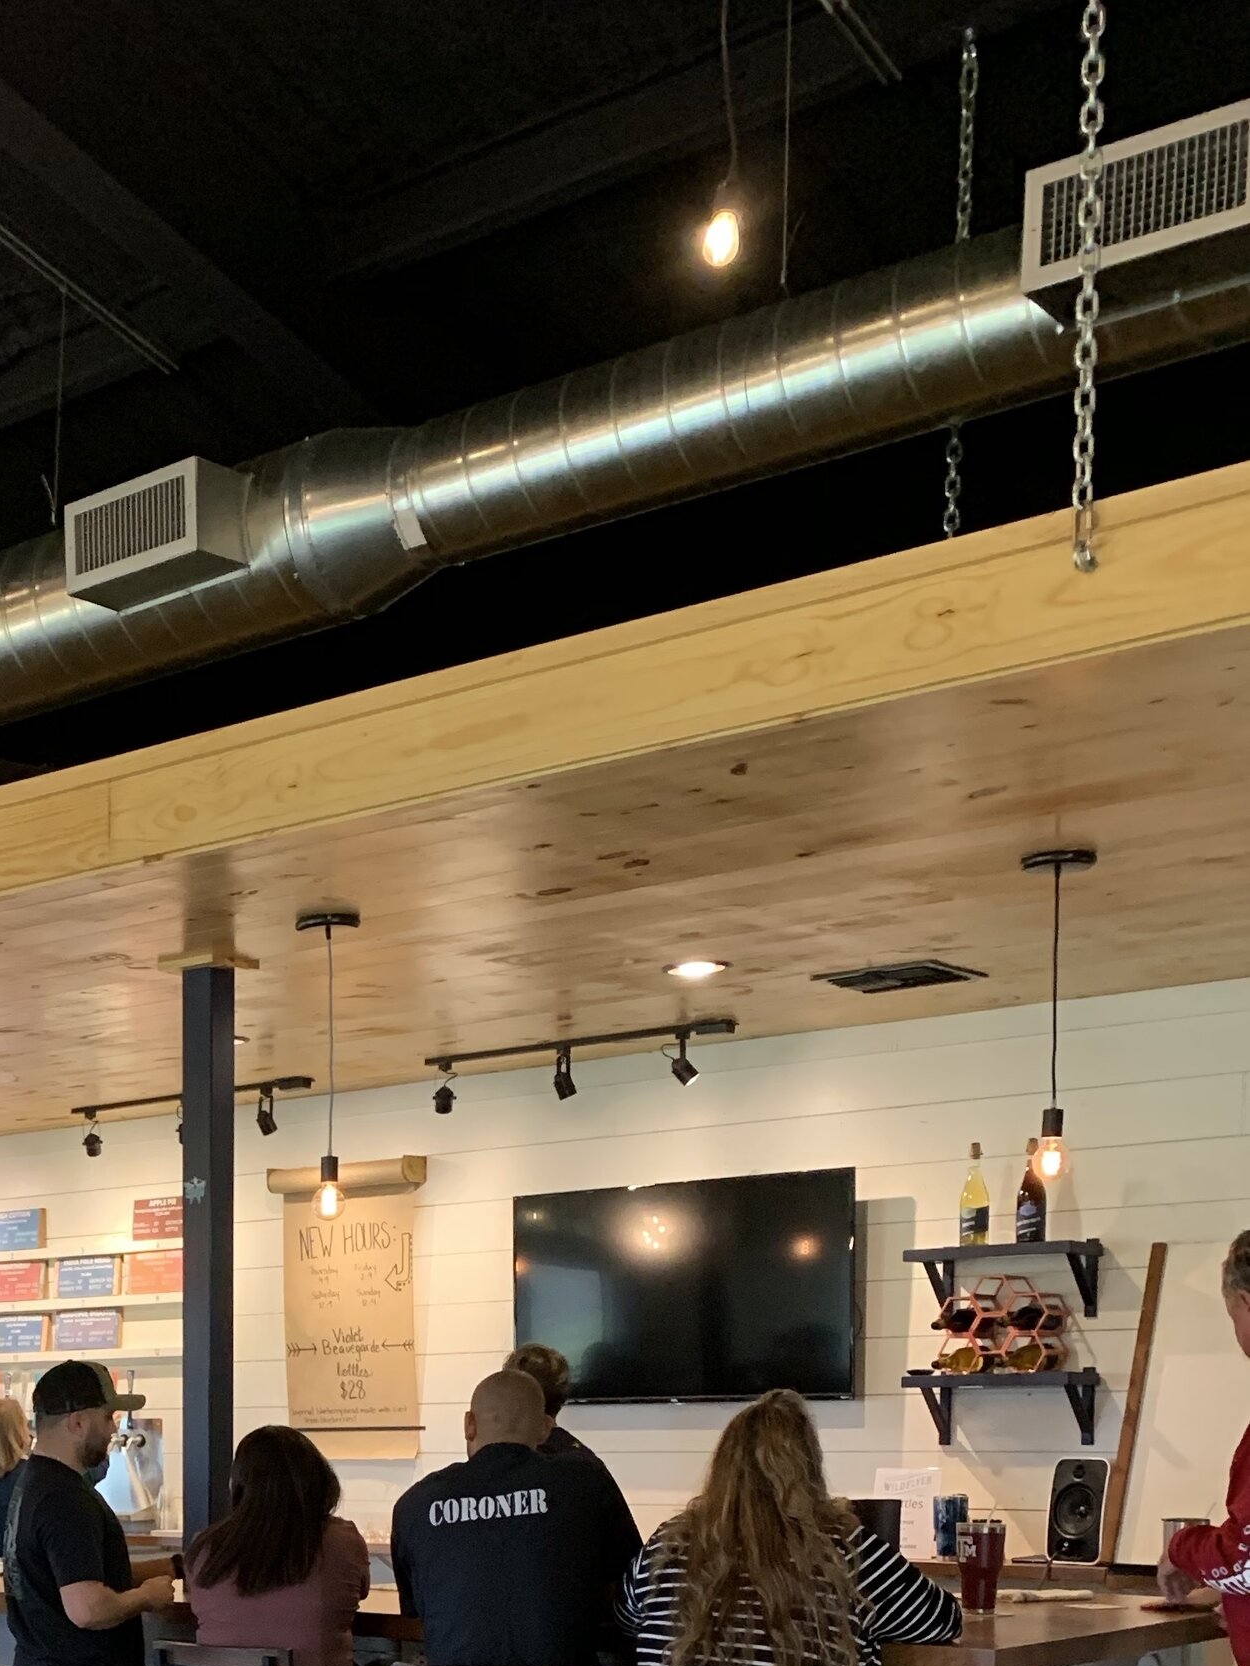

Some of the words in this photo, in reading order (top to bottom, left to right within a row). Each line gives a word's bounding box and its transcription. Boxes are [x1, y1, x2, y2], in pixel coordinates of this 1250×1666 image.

[299, 1224, 334, 1262] NEW
[343, 1221, 396, 1255] HOURS:
[332, 1326, 364, 1344] Violet
[340, 1379, 367, 1401] $28
[883, 1475, 933, 1492] WILDFLYER
[429, 1488, 549, 1527] CORONER
